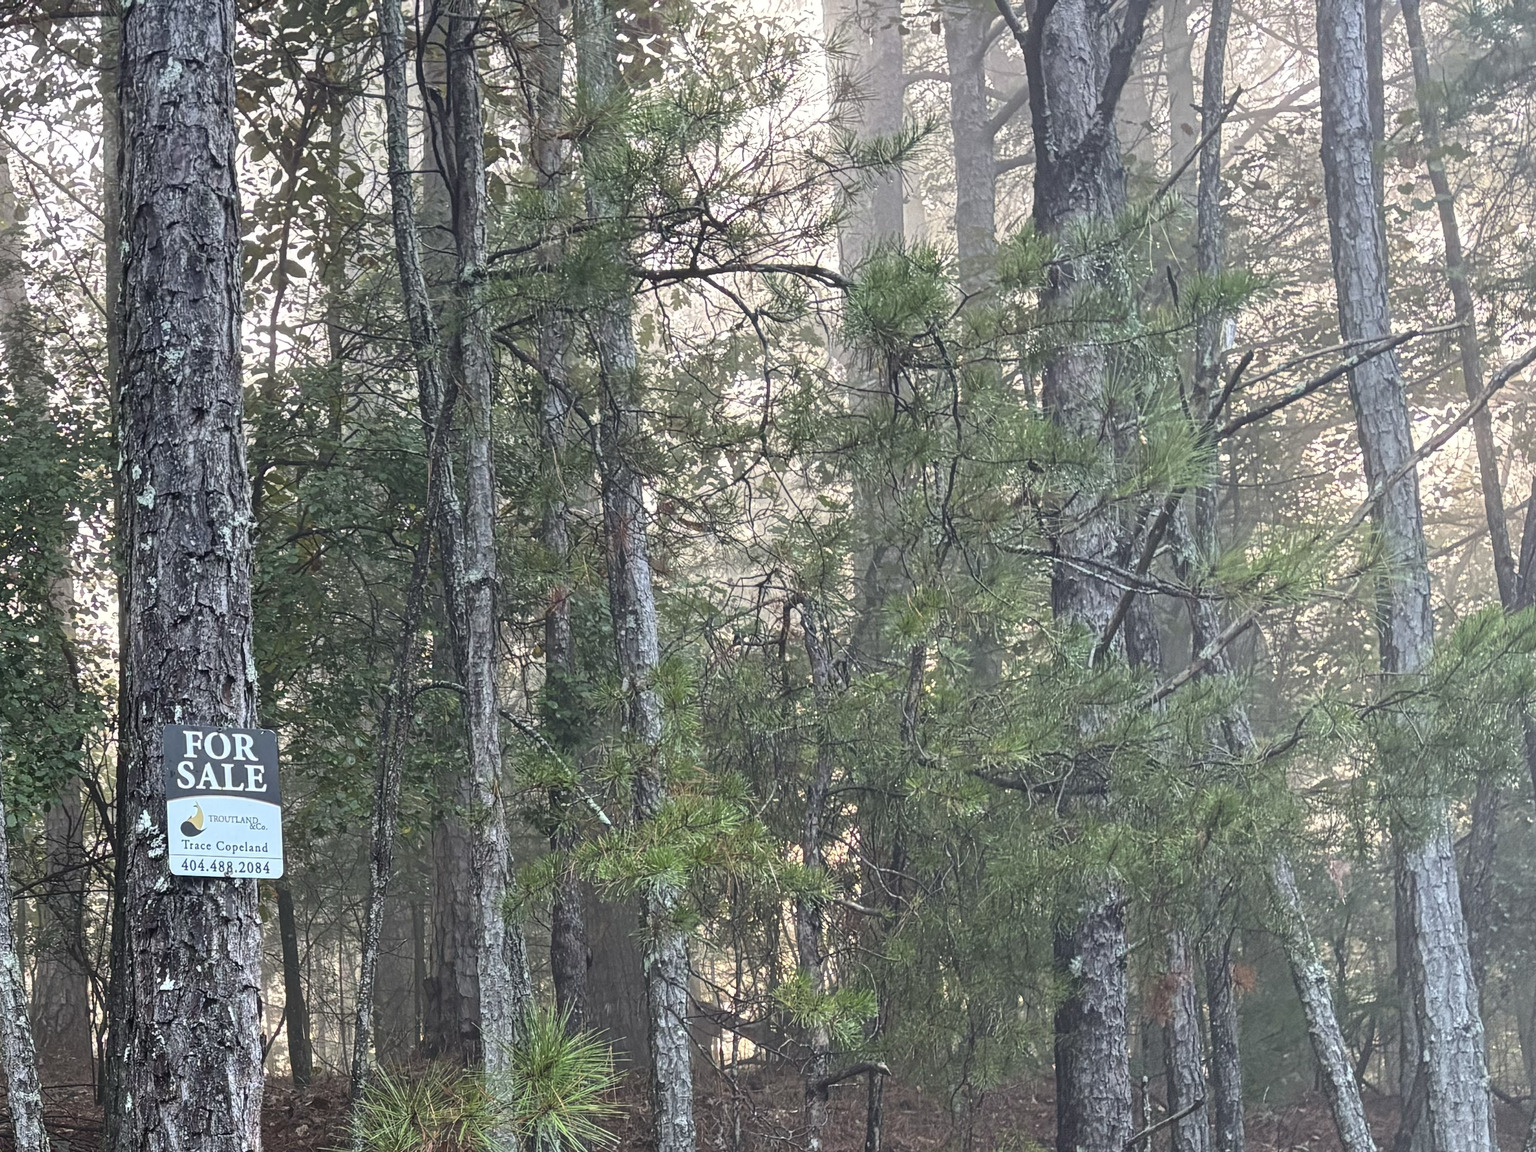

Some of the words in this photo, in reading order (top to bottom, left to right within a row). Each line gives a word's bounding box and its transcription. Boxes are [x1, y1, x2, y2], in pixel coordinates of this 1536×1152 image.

[182, 730, 260, 762] FOR
[176, 761, 268, 793] SALE
[208, 815, 259, 825] TROUTLAND
[181, 839, 212, 851] Trace
[216, 841, 269, 855] Copeland
[181, 858, 271, 874] 404.488.2084
